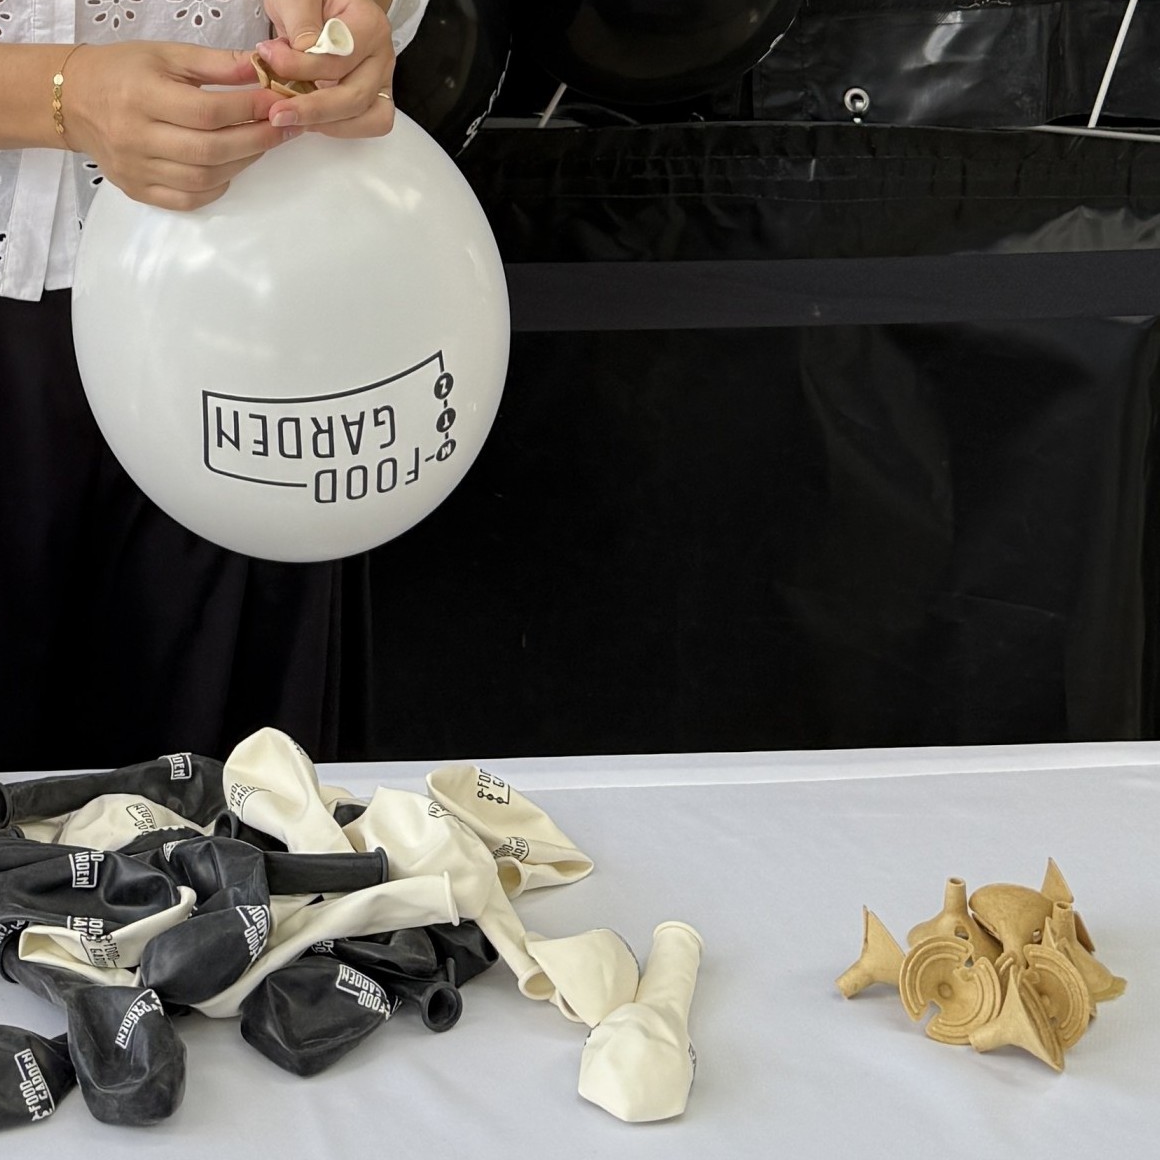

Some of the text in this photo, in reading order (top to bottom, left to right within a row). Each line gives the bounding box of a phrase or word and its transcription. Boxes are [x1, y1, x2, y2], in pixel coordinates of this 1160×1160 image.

[215, 404, 396, 460] GARDEN
[314, 446, 420, 504] FOOD
[358, 990, 386, 1014] FOOD
[19, 1079, 41, 1113] FOOD
